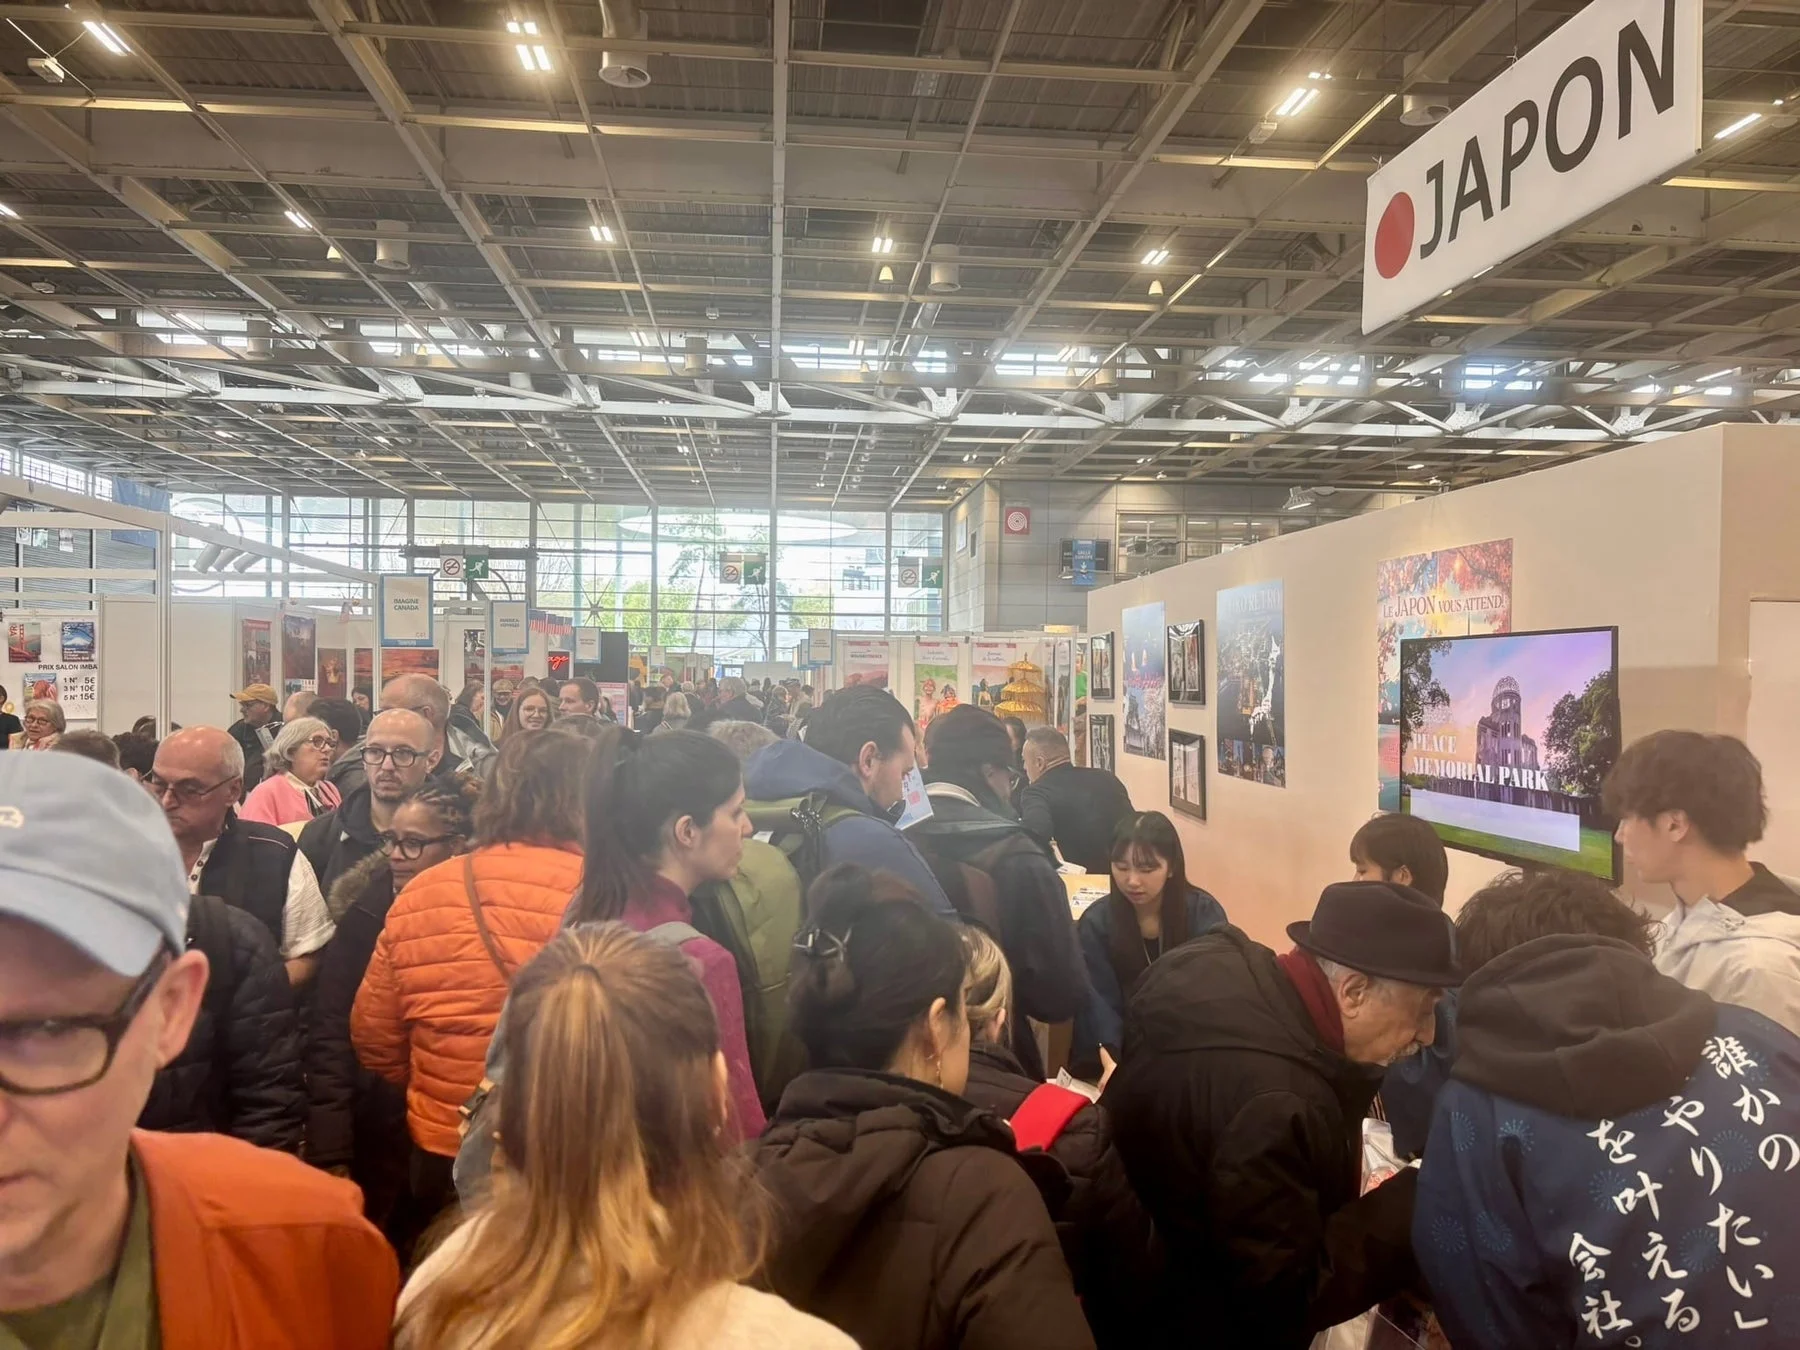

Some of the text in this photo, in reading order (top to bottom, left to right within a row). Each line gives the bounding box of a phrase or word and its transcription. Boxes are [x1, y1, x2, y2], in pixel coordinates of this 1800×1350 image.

[1420, 0, 1675, 259] JAPON
[1383, 604, 1394, 618] LE
[1395, 595, 1436, 617] JAPON
[1438, 598, 1463, 613] VOUS
[80, 684, 95, 692] 10€
[84, 676, 95, 684] 5€
[1412, 733, 1457, 754] PEACE
[1412, 756, 1550, 792] MEMORIAL PARK
[1585, 1118, 1701, 1333] を叶える
